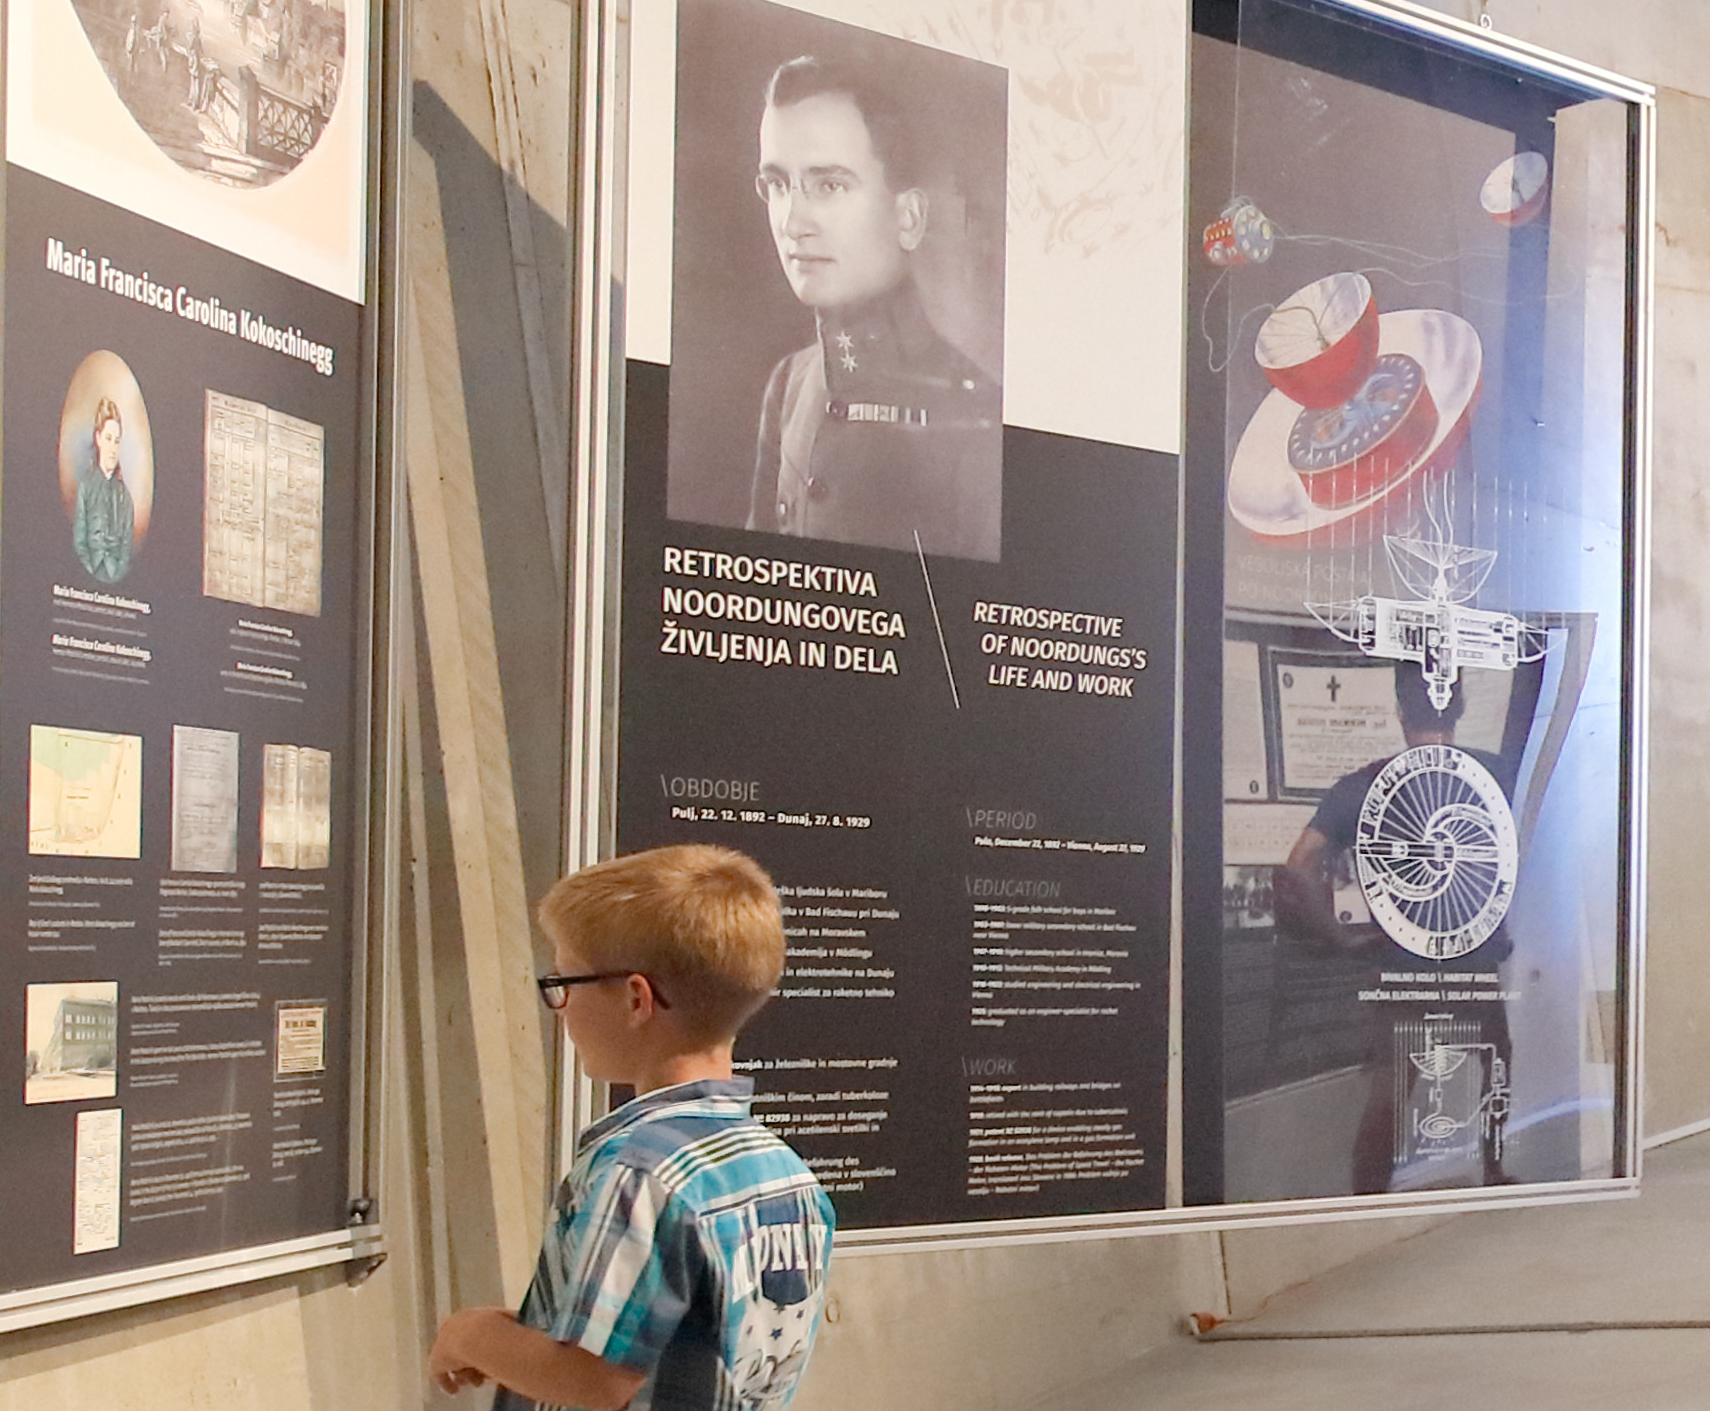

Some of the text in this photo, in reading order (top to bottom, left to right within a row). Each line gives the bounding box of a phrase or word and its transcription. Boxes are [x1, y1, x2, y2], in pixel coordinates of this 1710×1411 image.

[46, 238, 334, 377] Maria Francisca Carolina Kokoschinegg
[663, 546, 878, 598] RETROSPEKTIVA
[663, 587, 906, 639] NOORDUNGOVEGA
[973, 601, 1124, 638] RETROSPECTIVE
[660, 618, 899, 675] ŽIVLJENJA IN DELA
[981, 633, 1008, 654] OF
[988, 664, 1135, 698] LIFE AND WORK
[671, 807, 699, 821] Pulj,
[701, 808, 718, 821] 22.
[721, 810, 737, 821] 12.
[740, 811, 766, 822] 1892
[778, 812, 813, 827] Dunaj,
[815, 815, 830, 826] 27.
[832, 816, 843, 827] 8.
[846, 817, 871, 828] 1929
